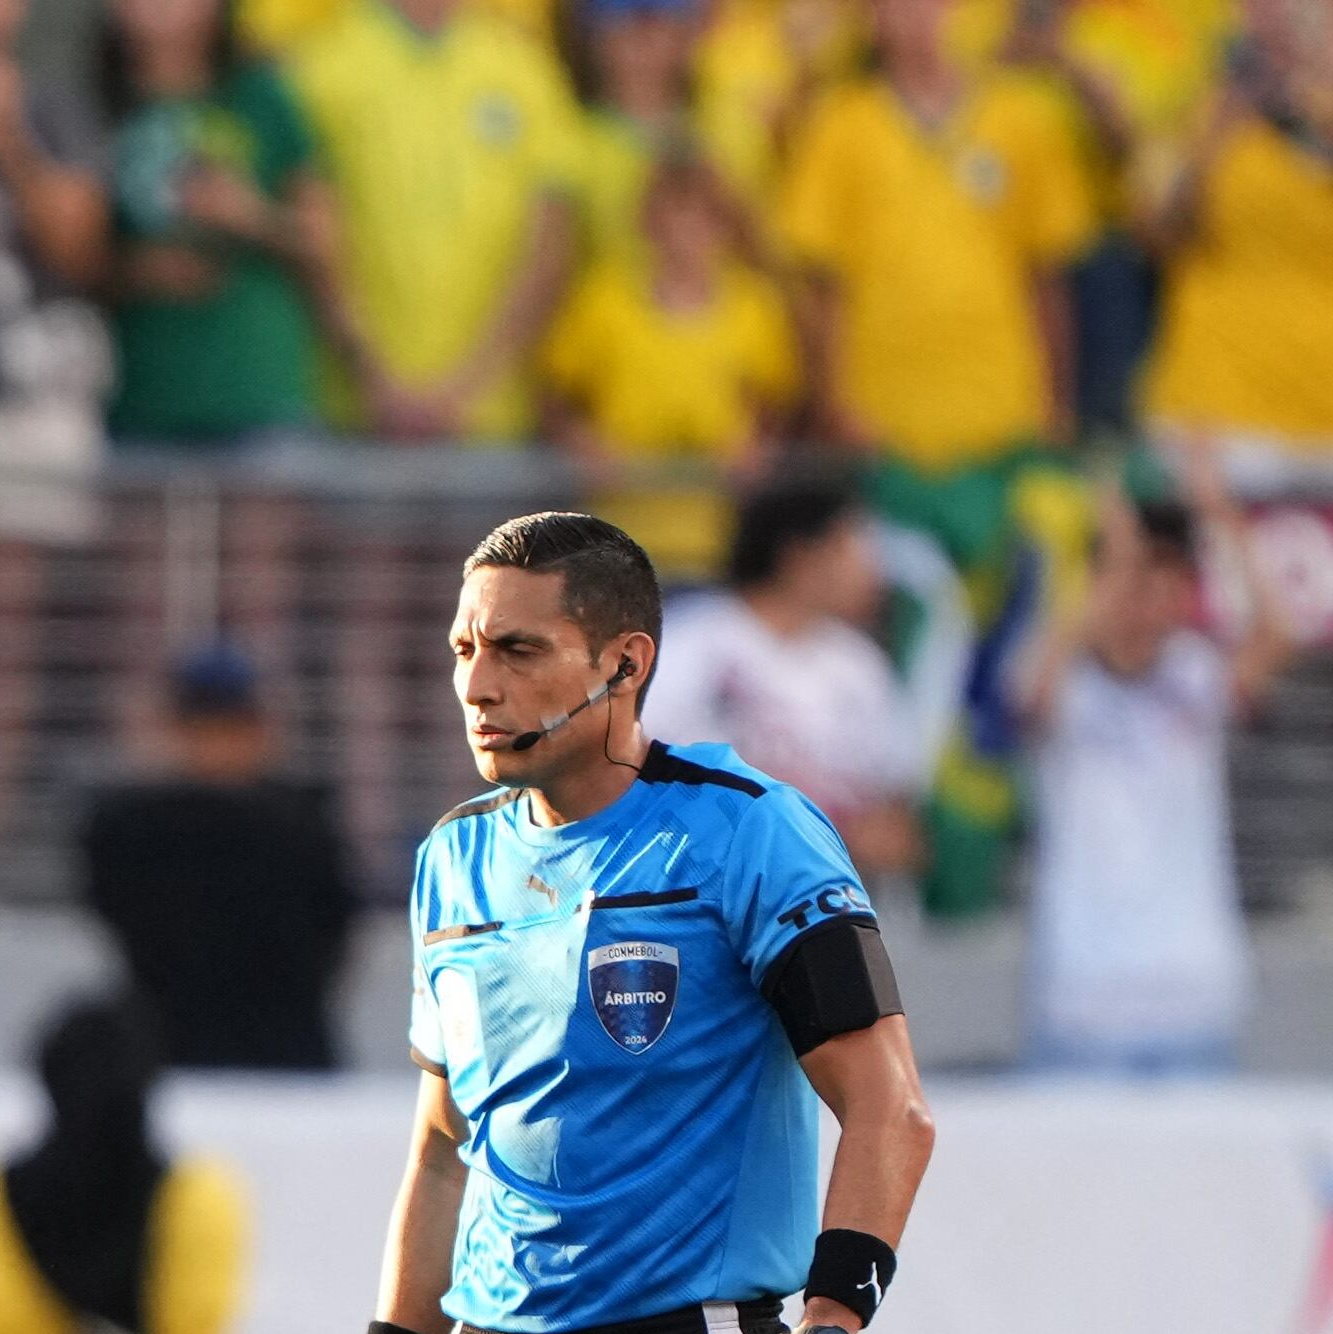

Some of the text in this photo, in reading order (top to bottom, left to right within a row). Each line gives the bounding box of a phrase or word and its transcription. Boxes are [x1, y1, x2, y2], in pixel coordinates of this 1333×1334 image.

[777, 884, 870, 930] TCL
[604, 991, 667, 1006] ÁRBITRO
[624, 1035, 648, 1045] 2024
